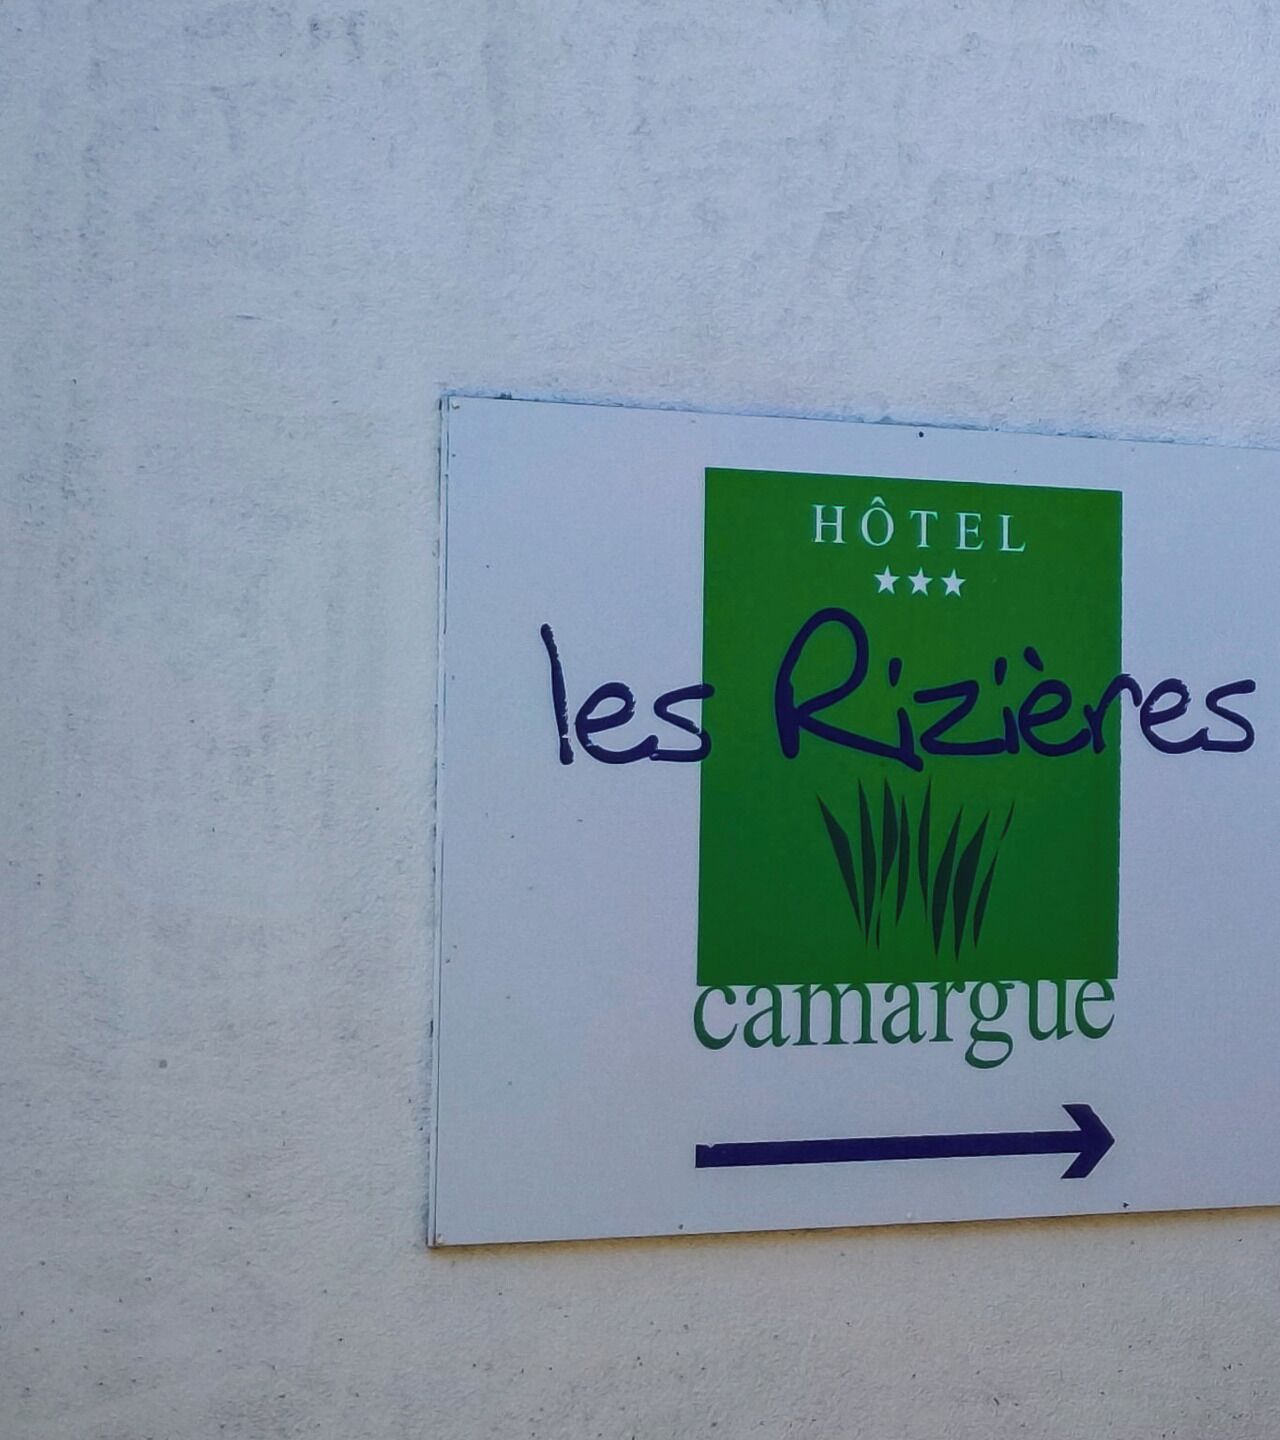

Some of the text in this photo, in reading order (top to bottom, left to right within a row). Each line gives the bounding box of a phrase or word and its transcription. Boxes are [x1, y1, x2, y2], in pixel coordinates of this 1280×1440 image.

[811, 496, 1026, 552] HÔTEL
[541, 608, 1257, 771] les Rizières
[693, 978, 1116, 1070] camargue
